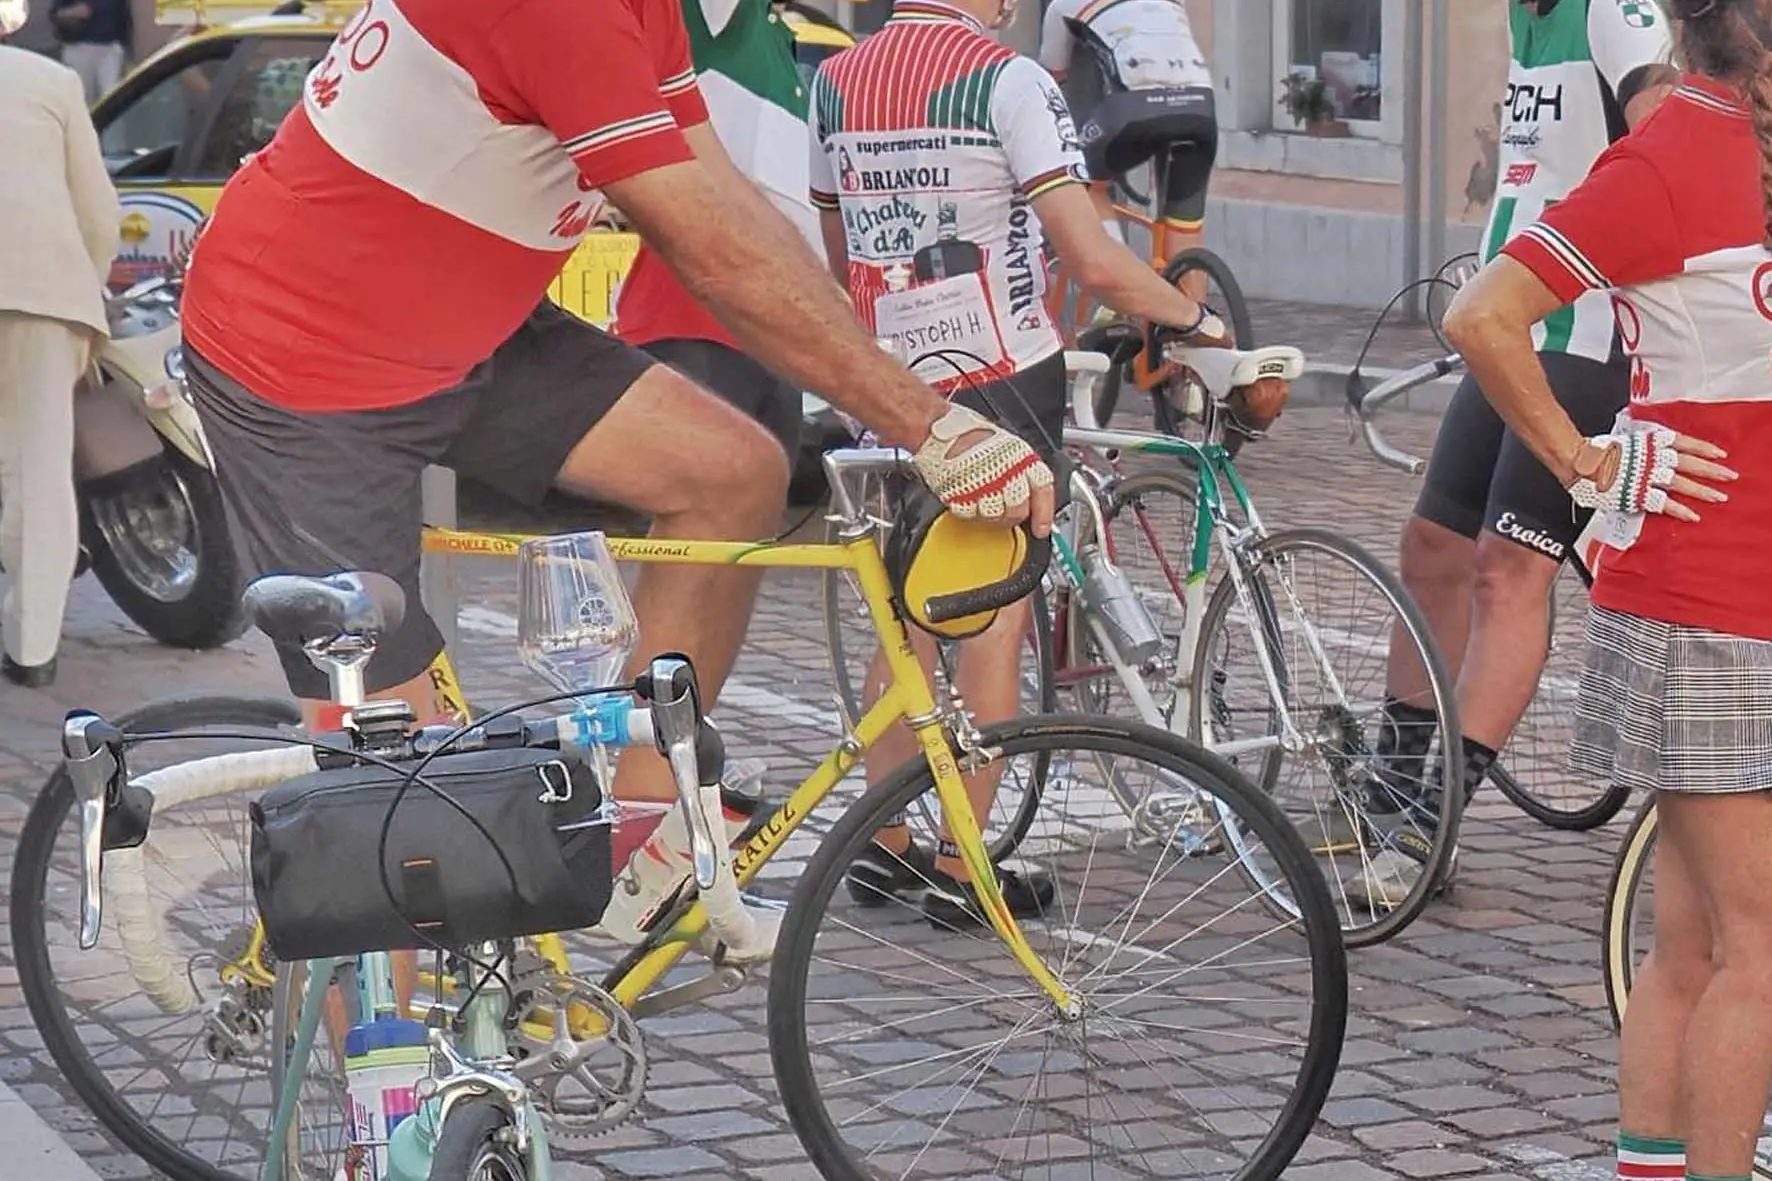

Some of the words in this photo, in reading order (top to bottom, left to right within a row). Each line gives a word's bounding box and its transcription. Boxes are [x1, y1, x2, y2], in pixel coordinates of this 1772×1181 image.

[856, 135, 947, 156] supermercati
[862, 167, 950, 191] BRIANOLI
[1496, 511, 1564, 557] Eroica
